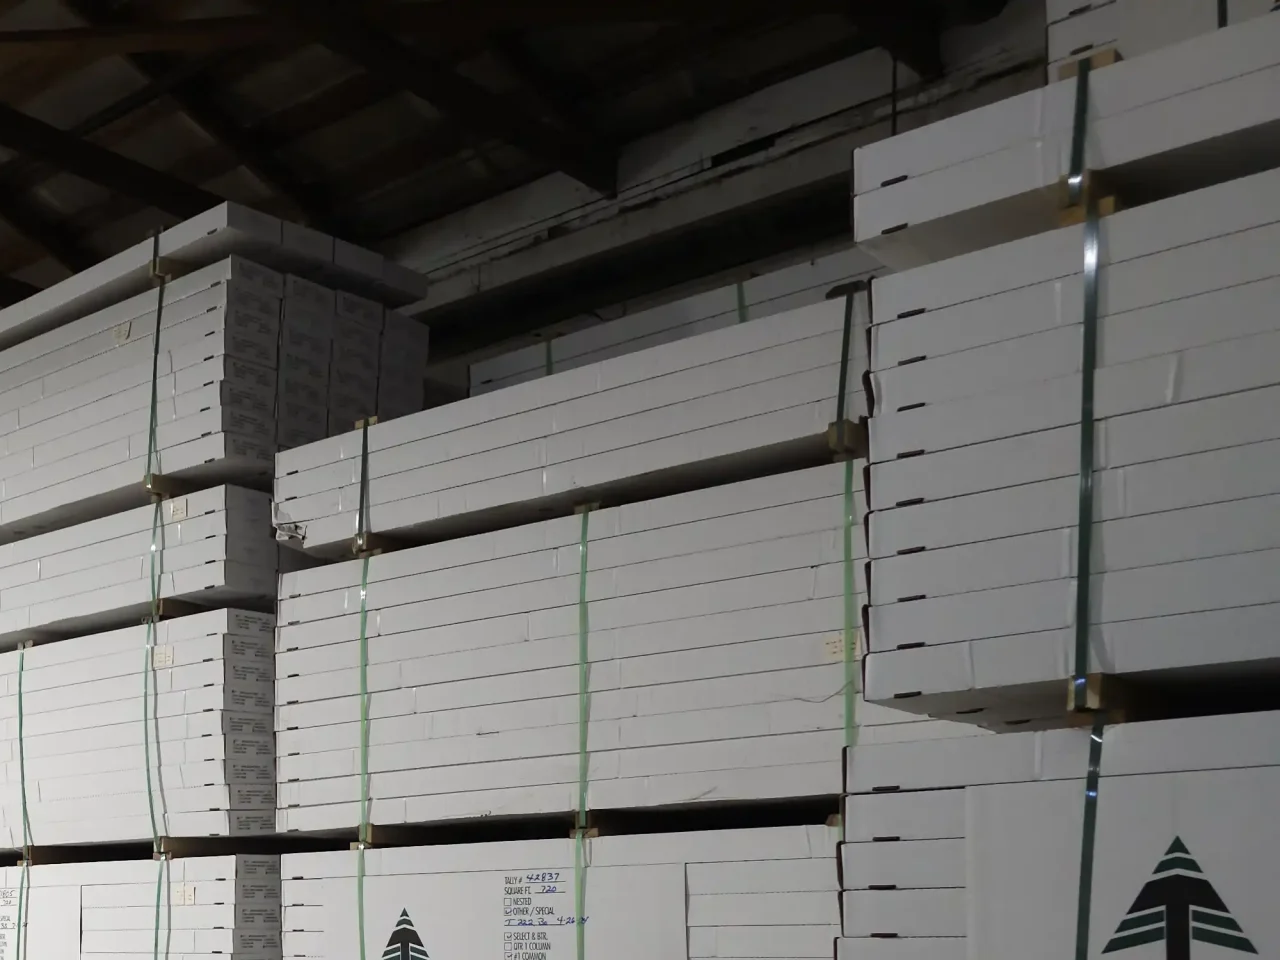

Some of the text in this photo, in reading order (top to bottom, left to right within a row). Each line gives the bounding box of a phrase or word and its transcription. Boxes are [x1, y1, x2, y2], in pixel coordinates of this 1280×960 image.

[505, 876, 518, 885] TALLY
[526, 873, 560, 881] 42837
[504, 887, 525, 895] SQUARE
[541, 885, 557, 893] 720
[513, 898, 532, 906] NESTED
[513, 907, 529, 916] OTHER
[535, 907, 555, 915] SPECIAL
[513, 932, 529, 941] SELECT
[513, 942, 523, 951] QTR
[529, 942, 551, 950] COLUMN
[513, 952, 547, 960] #1 COMMON
